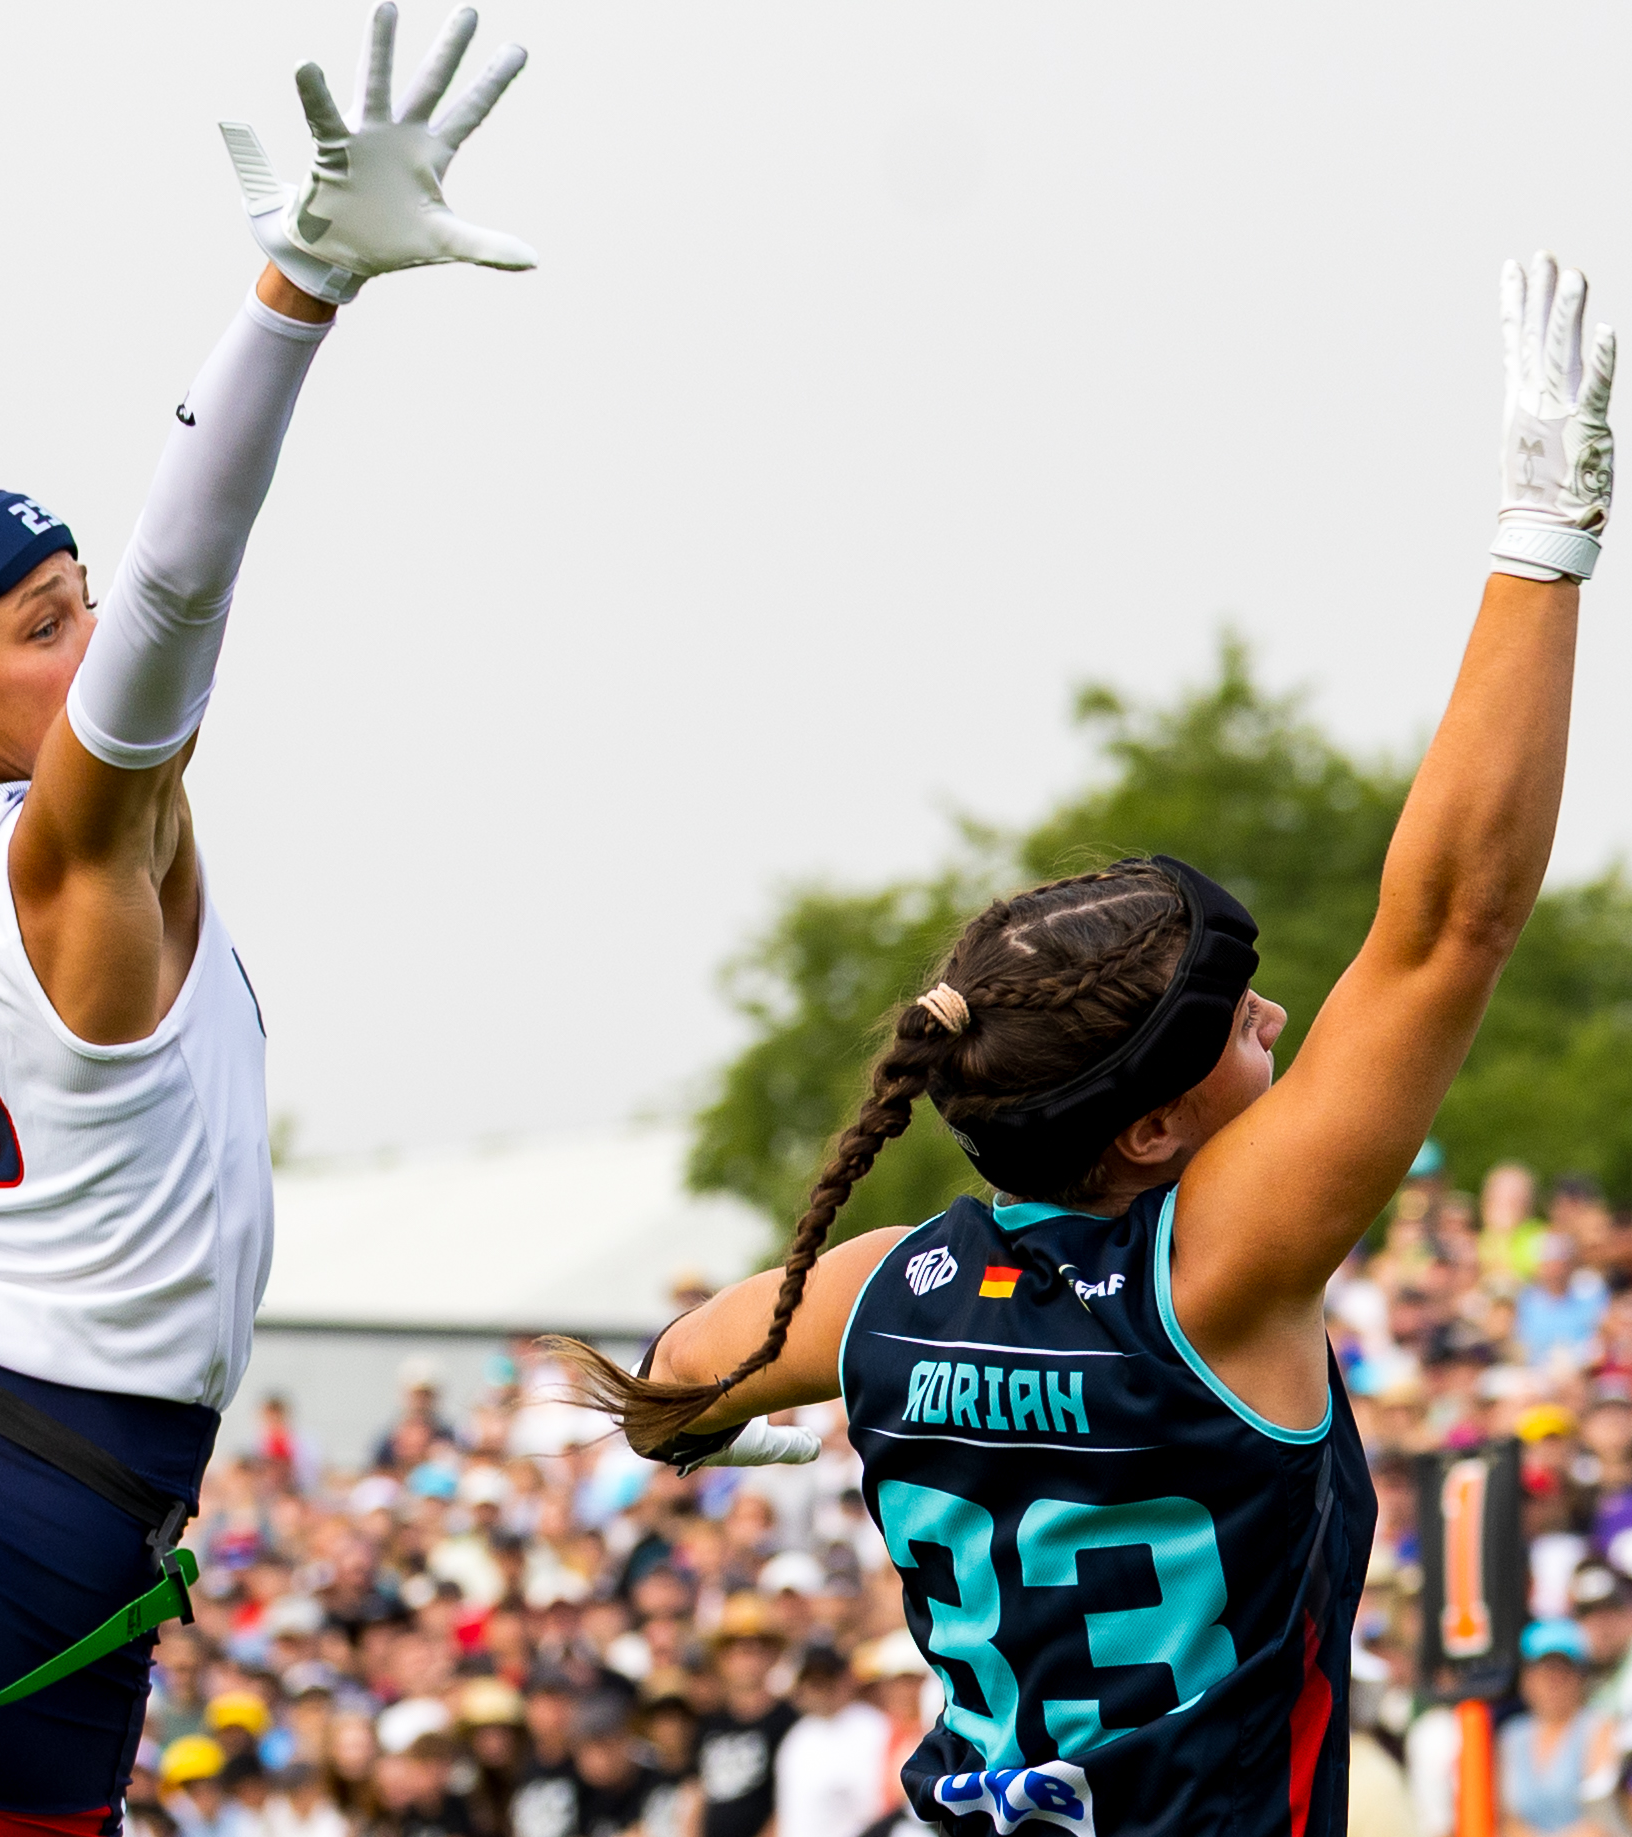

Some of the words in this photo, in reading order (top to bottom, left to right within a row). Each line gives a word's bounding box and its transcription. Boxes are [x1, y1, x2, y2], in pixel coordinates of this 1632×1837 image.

[8, 500, 64, 536] 23
[901, 1360, 1090, 1434] ADRIAN
[877, 1479, 1238, 1774] 33
